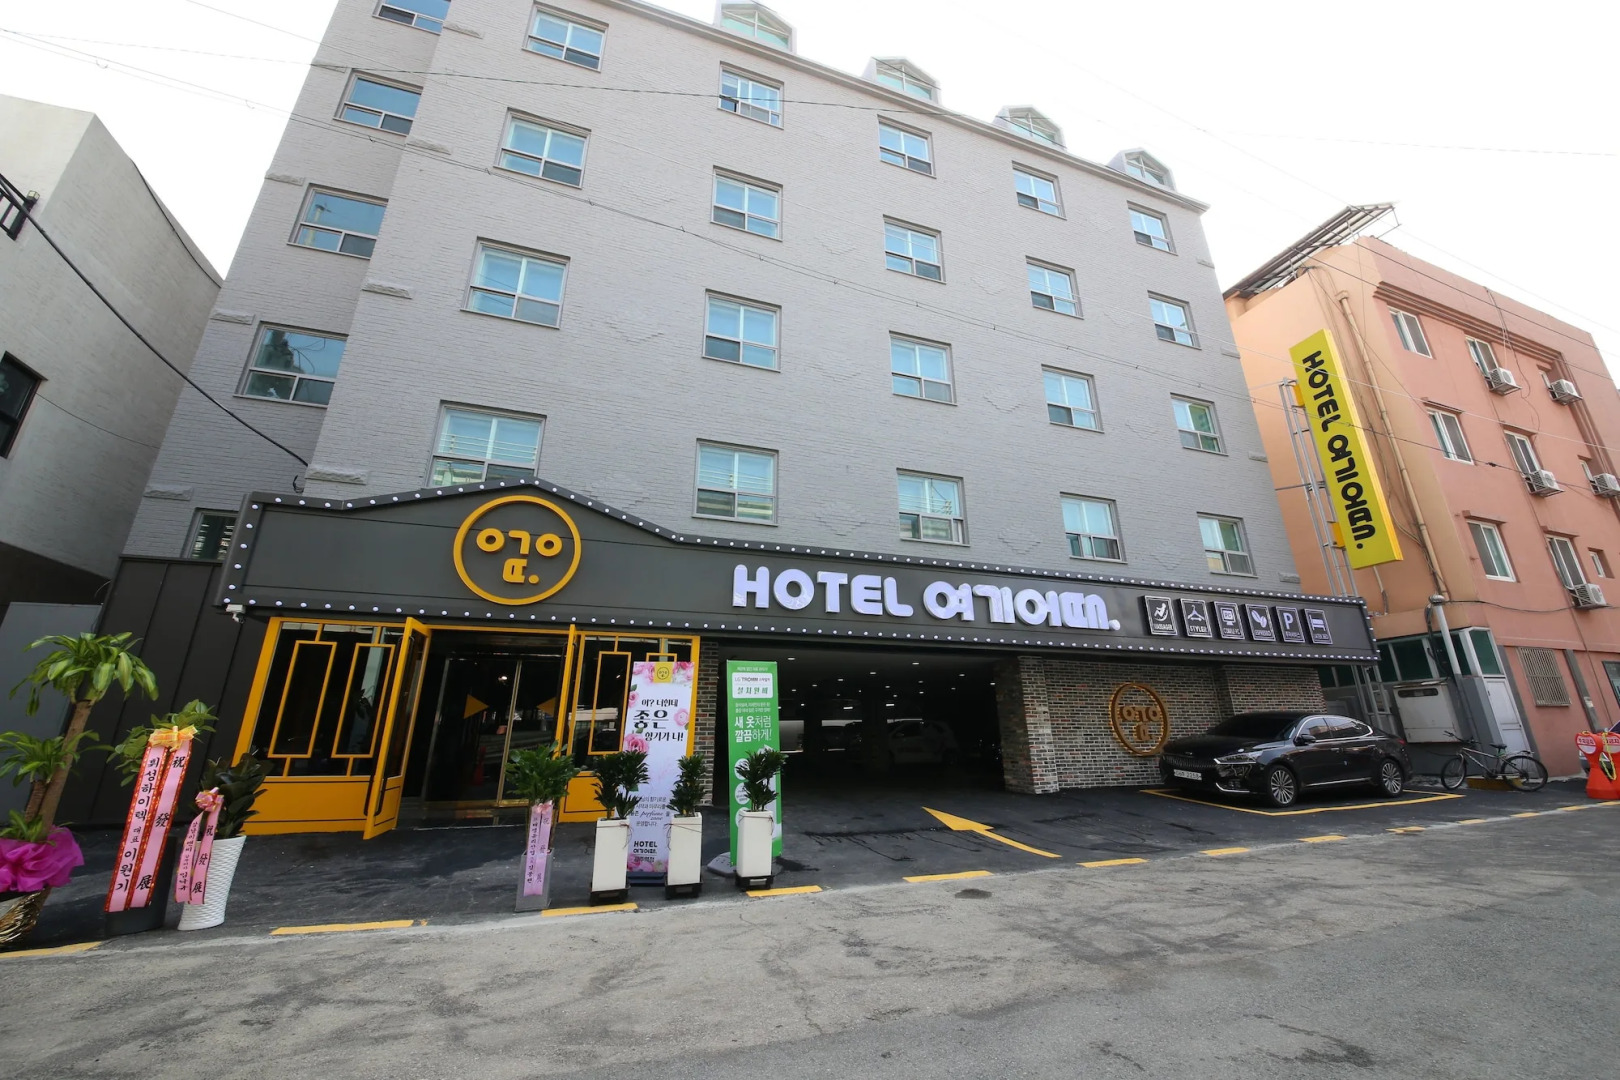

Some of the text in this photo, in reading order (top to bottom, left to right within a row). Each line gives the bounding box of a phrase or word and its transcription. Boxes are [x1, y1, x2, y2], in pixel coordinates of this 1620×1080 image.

[1302, 350, 1341, 433] HOTEL
[732, 564, 915, 618] HOTEL
[632, 709, 669, 729] 좋은
[734, 715, 772, 729] 새 옷처럼
[645, 731, 670, 742] 향기가
[735, 729, 772, 743] 깔끔하게!
[116, 848, 137, 893] 이원기
